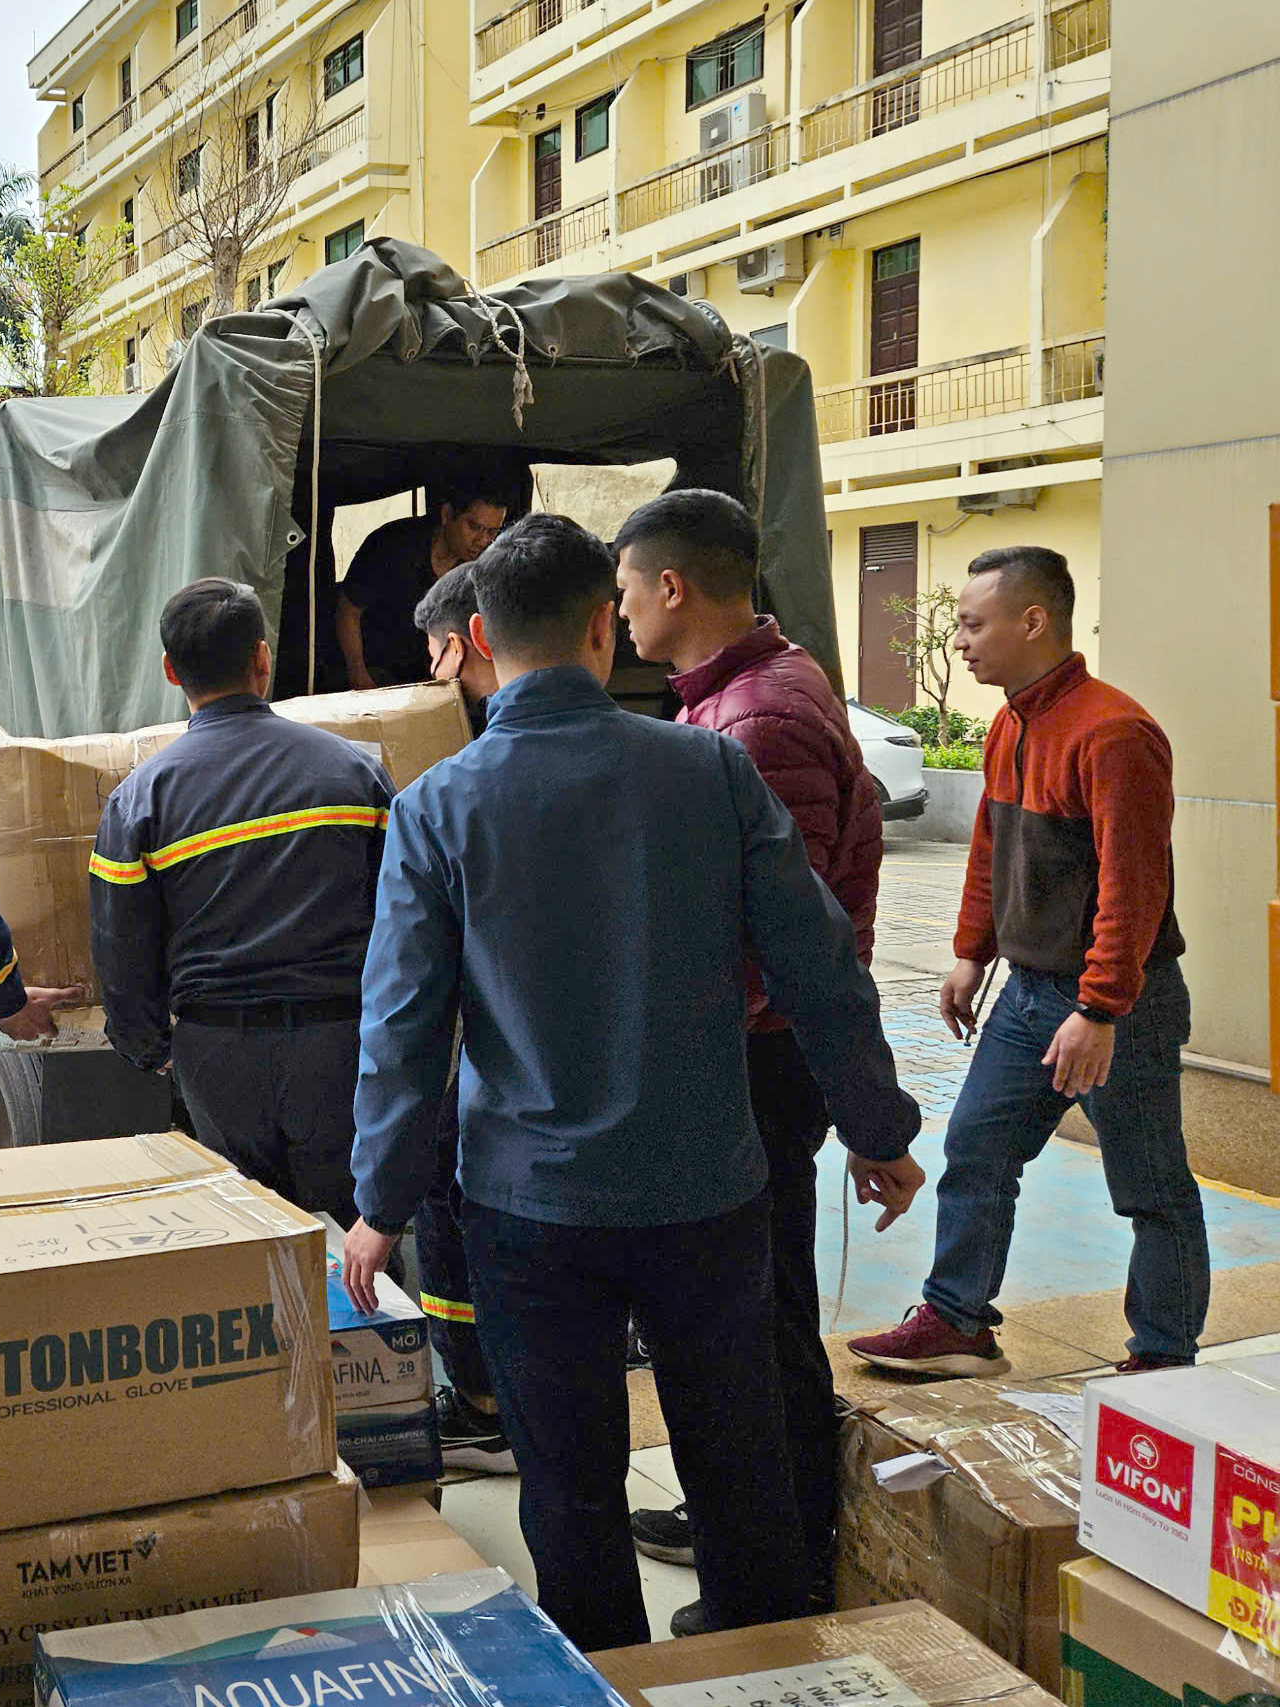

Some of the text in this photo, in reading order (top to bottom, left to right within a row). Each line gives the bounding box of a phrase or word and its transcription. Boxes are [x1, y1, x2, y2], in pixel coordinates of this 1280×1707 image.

[126, 1378, 188, 1400] GLOVE
[1106, 1456, 1182, 1512] VIFON
[1233, 1463, 1280, 1494] CÔNG
[1232, 1546, 1270, 1572] INSTA
